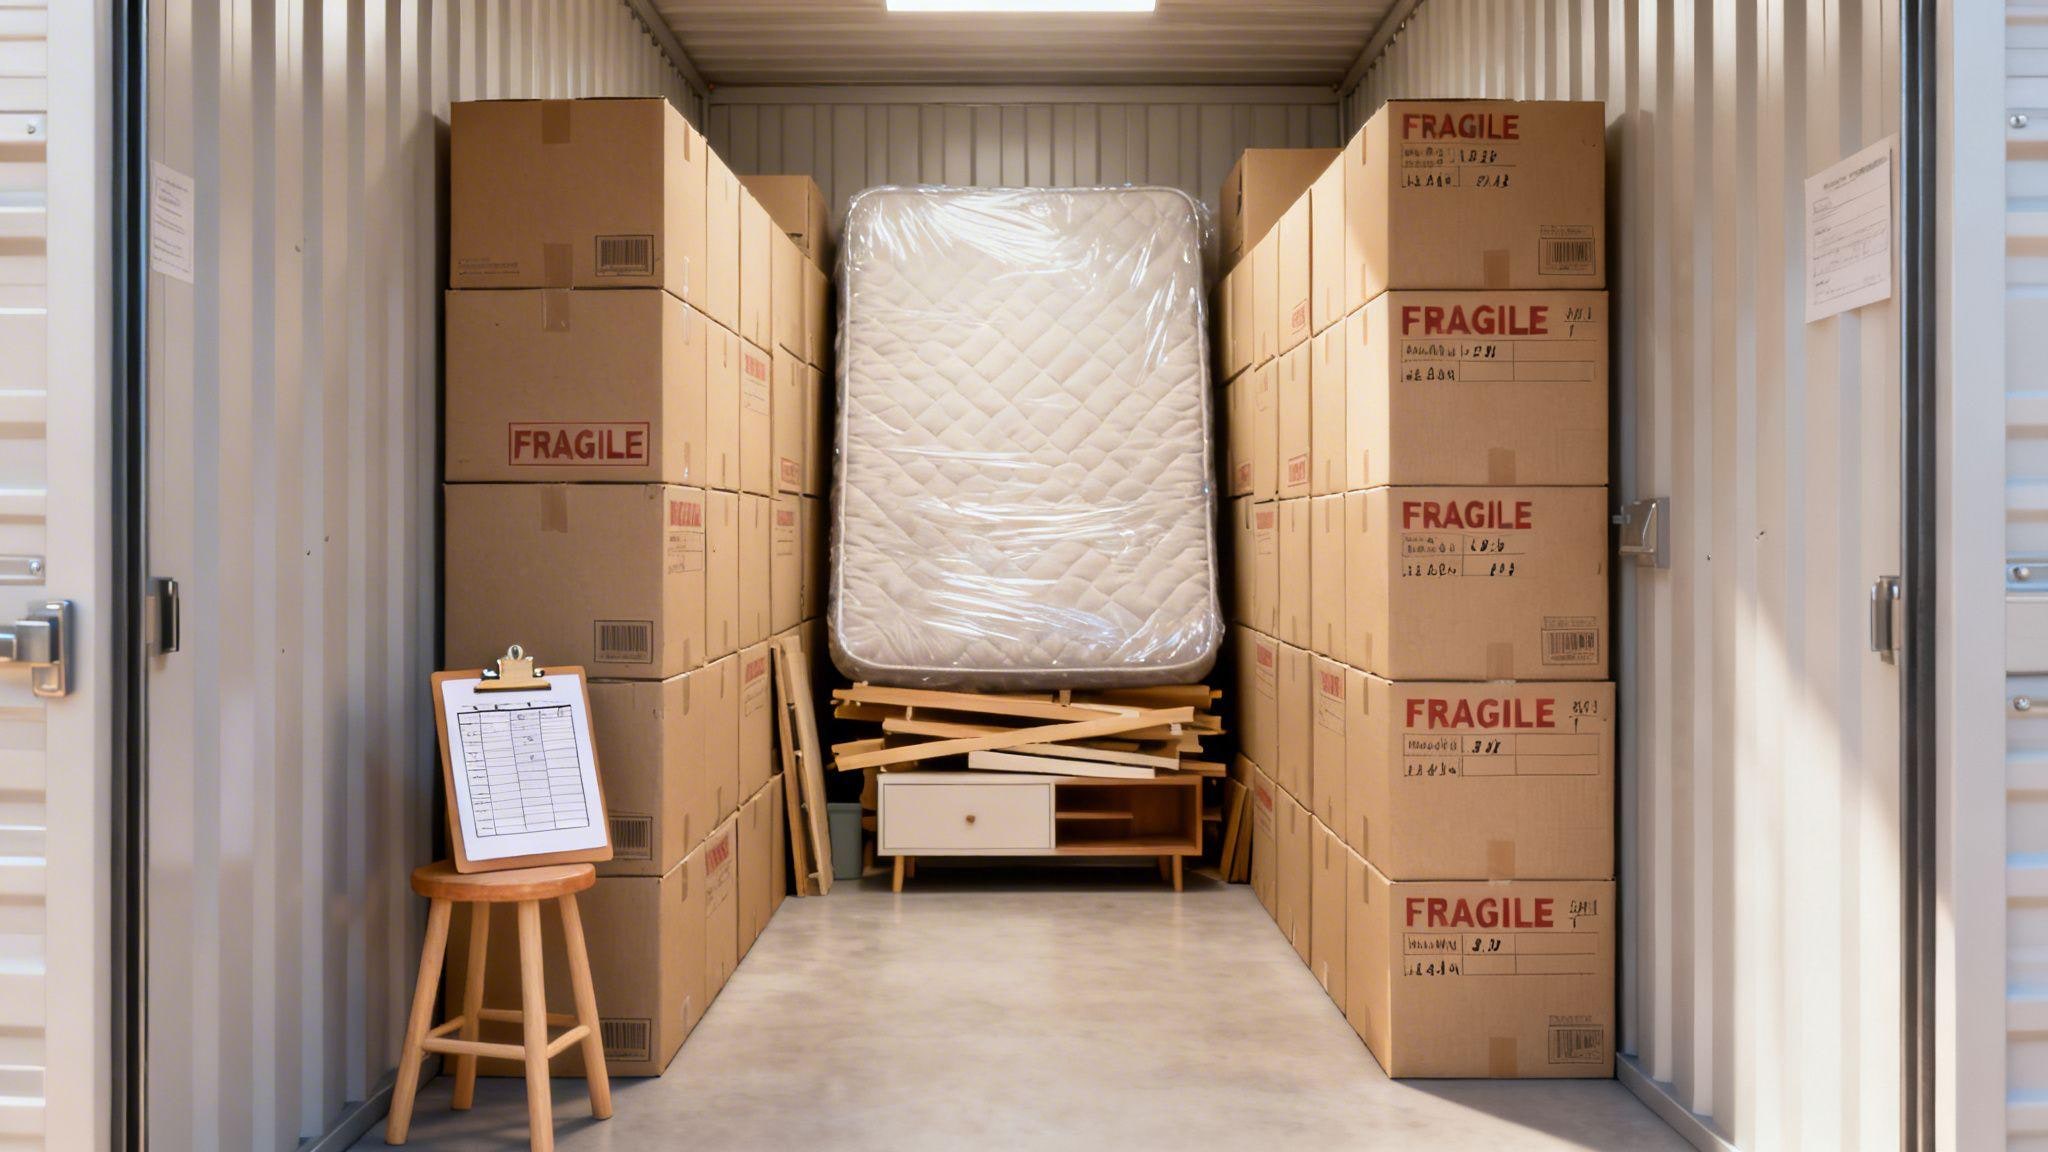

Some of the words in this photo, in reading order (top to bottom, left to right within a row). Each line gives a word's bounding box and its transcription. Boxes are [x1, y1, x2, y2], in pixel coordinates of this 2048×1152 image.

[1402, 113, 1519, 140] FRAGILE
[1402, 305, 1548, 336] FRAGILE
[513, 429, 643, 460] FRAGILE
[1402, 500, 1532, 529] FRAGILE
[1406, 698, 1555, 729] FRAGILE
[1406, 897, 1553, 928] FRAGILE
